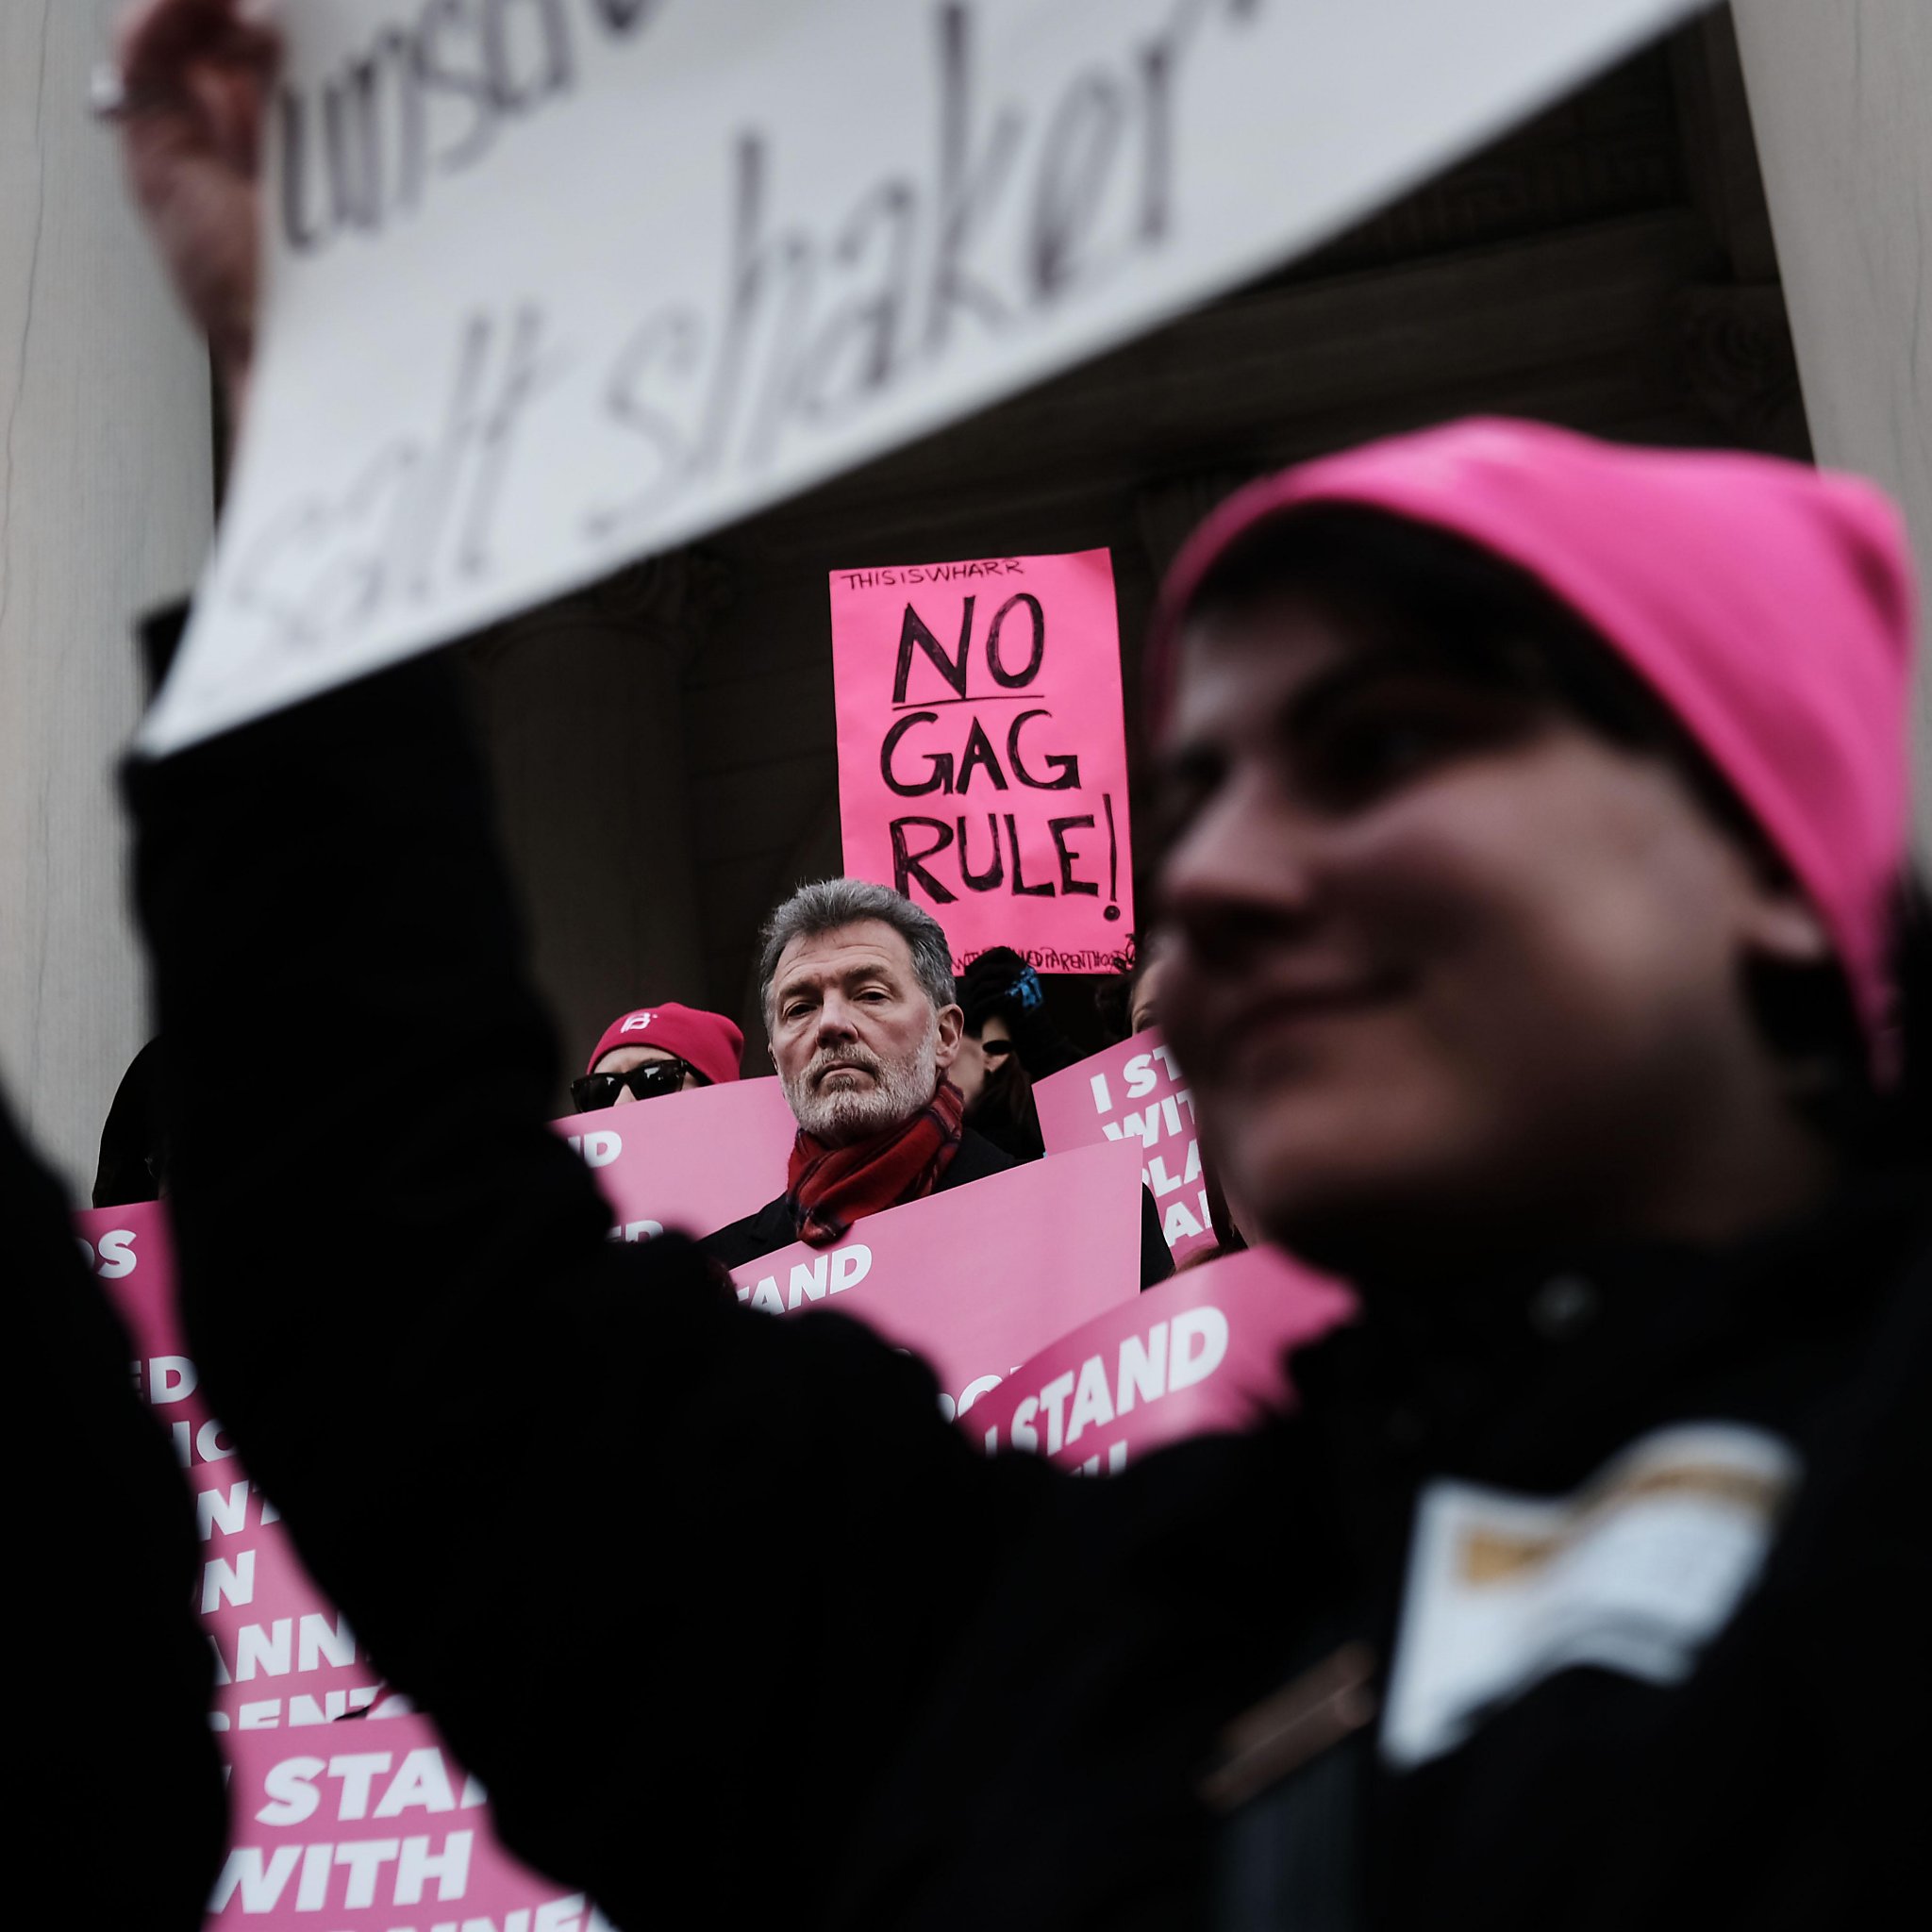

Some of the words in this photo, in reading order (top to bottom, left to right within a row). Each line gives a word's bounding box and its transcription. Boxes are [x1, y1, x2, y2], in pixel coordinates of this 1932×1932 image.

[269, 0, 651, 255] unsa
[892, 592, 1044, 704] NO
[880, 708, 1081, 797] GAG
[889, 792, 1121, 921] RULE!
[1090, 1073, 1113, 1115] I
[1123, 1043, 1183, 1099] ST
[1102, 1087, 1196, 1149] WIT
[737, 1243, 873, 1317] AND
[1010, 1306, 1230, 1458] STAND
[208, 1827, 475, 1915] WITH
